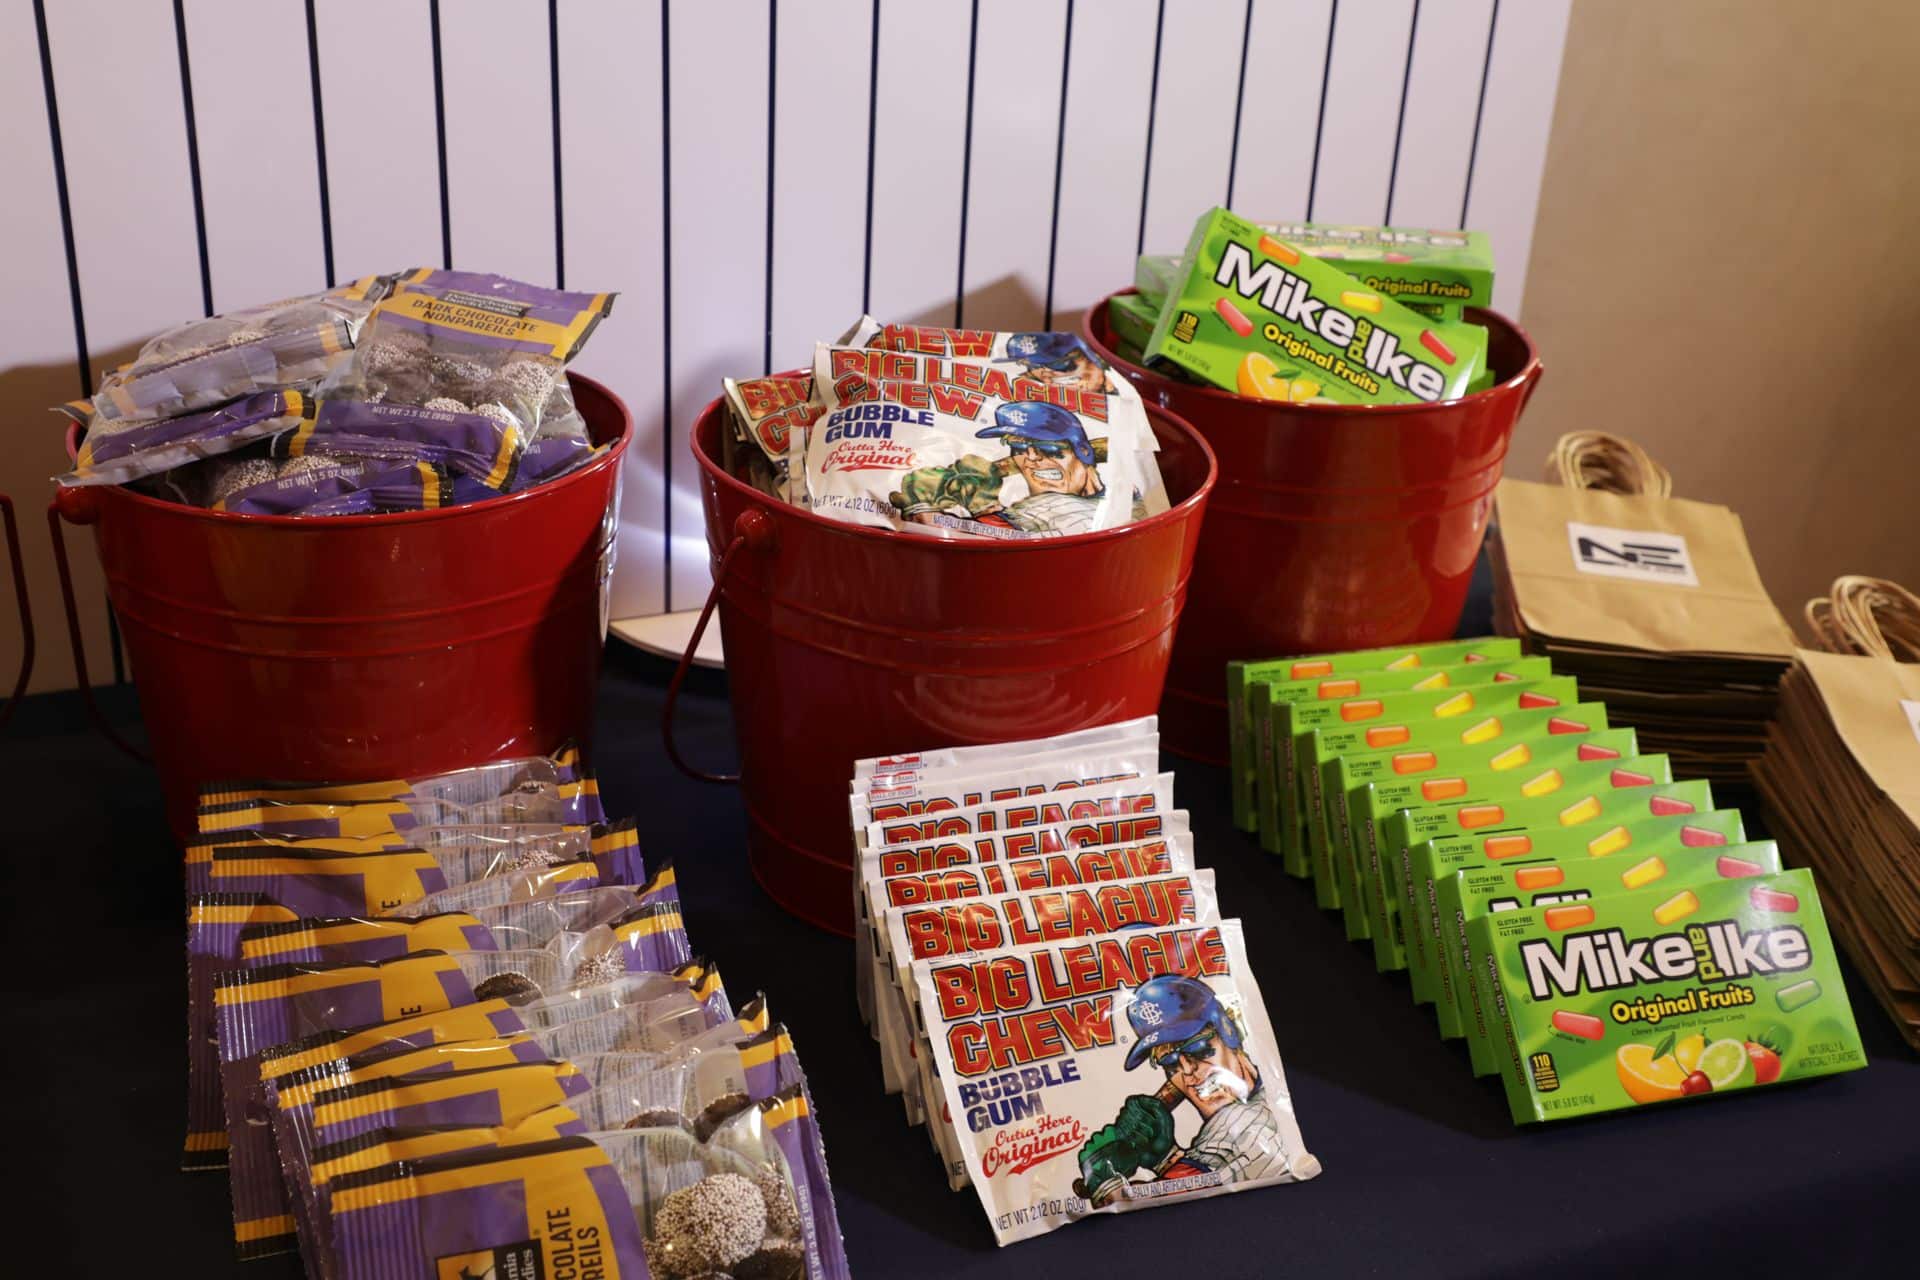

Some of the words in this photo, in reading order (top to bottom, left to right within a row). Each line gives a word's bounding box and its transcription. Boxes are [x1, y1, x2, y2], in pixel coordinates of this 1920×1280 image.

[1366, 276, 1429, 297] Original
[1430, 282, 1473, 299] Fruits
[412, 299, 454, 313] DARK
[455, 307, 539, 332] CHOCOLATE
[422, 310, 517, 336] NONPAREILS
[1182, 312, 1199, 327] 110
[1214, 239, 1356, 348] Mike
[1346, 317, 1375, 366] and
[1362, 326, 1447, 400] Ike
[1263, 322, 1337, 370] Original
[1333, 359, 1381, 395] Fruits
[830, 349, 917, 381] BIG
[923, 356, 1109, 423] LEAGUE
[833, 371, 986, 421] CHEW
[824, 422, 893, 444] GUM
[826, 404, 936, 429] BUBBLE
[820, 450, 916, 474] Original
[838, 441, 875, 453] Outta
[863, 498, 875, 513] OZ
[1468, 876, 1489, 885] GLUTEN
[1490, 874, 1504, 882] FREE
[1470, 887, 1480, 895] FAT
[1481, 886, 1495, 894] FREE
[902, 903, 1005, 961] BIG
[1001, 876, 1198, 946] LEAGUE
[1497, 919, 1518, 927] GLUTEN
[1518, 915, 1533, 924] FREE
[1499, 929, 1511, 937] FAT
[1511, 927, 1525, 936] FREE
[1519, 926, 1698, 1000] Mike
[1689, 925, 1725, 982] and
[1705, 918, 1812, 978] Ike
[931, 955, 1033, 1022] BIG
[1028, 926, 1231, 1003] LEAGUE
[1611, 988, 1699, 1024] Original
[1698, 983, 1756, 1010] Fruits
[945, 994, 1119, 1079] CHEW
[1532, 1054, 1551, 1068] 110
[957, 1058, 1082, 1110] BUBBLE
[966, 1091, 1047, 1134] GUM
[1036, 1113, 1074, 1134] Here
[981, 1119, 1087, 1179] Original
[995, 1214, 1014, 1231] NET
[1013, 1210, 1029, 1225] WT
[1029, 1204, 1048, 1220] 2.12
[1049, 1200, 1064, 1216] OZ
[1064, 1197, 1088, 1216] (60g)
